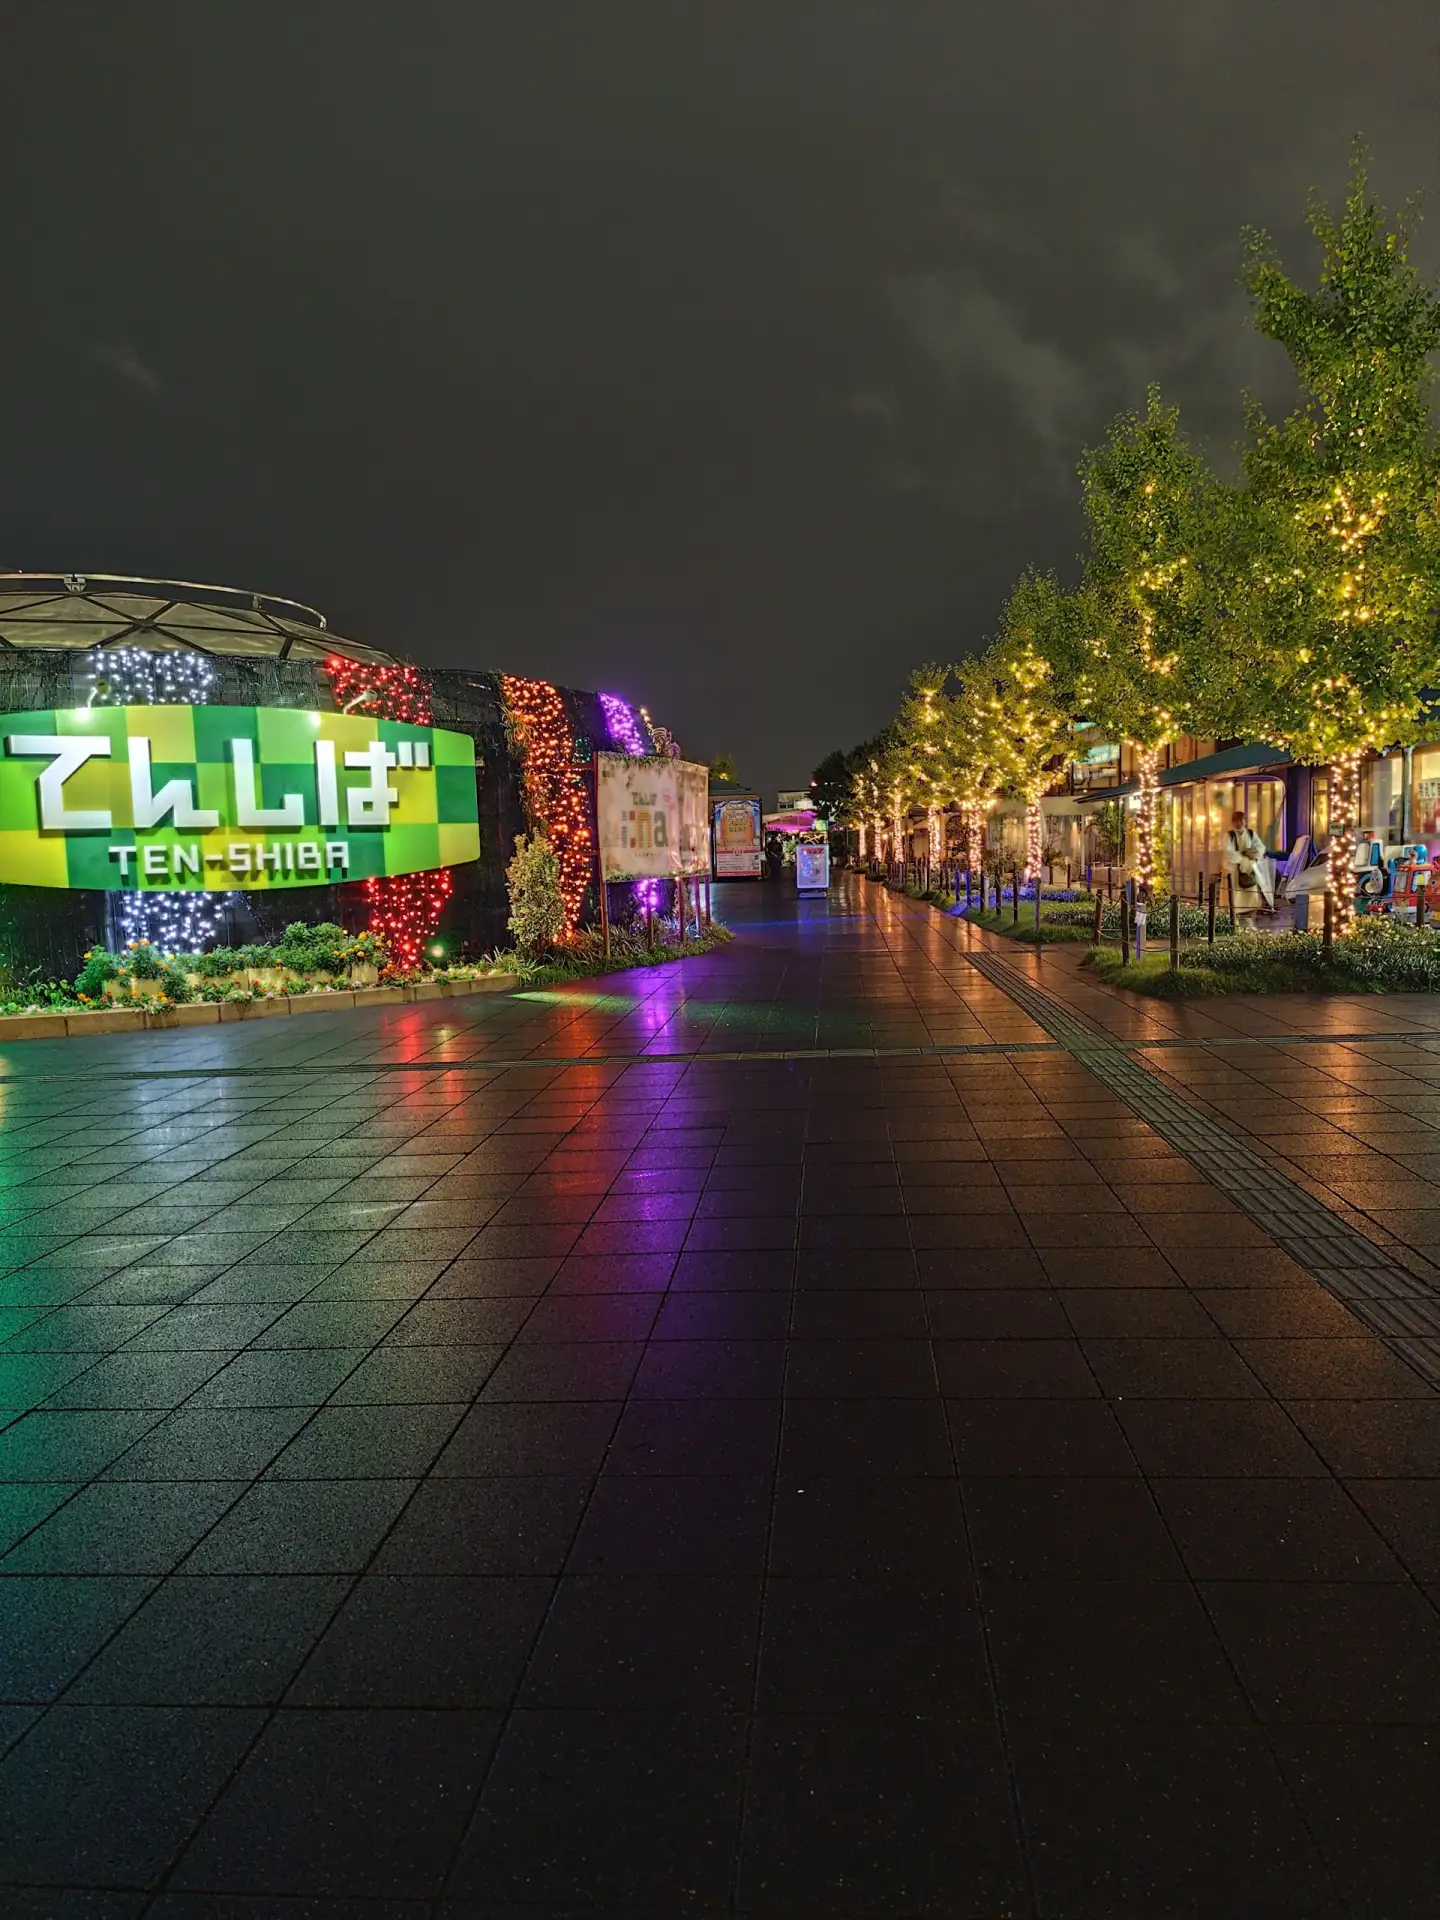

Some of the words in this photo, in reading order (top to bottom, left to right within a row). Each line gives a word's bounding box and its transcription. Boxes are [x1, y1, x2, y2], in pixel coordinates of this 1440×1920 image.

[8, 734, 430, 830] てんしば
[109, 840, 349, 876] TEN-SHIBA
